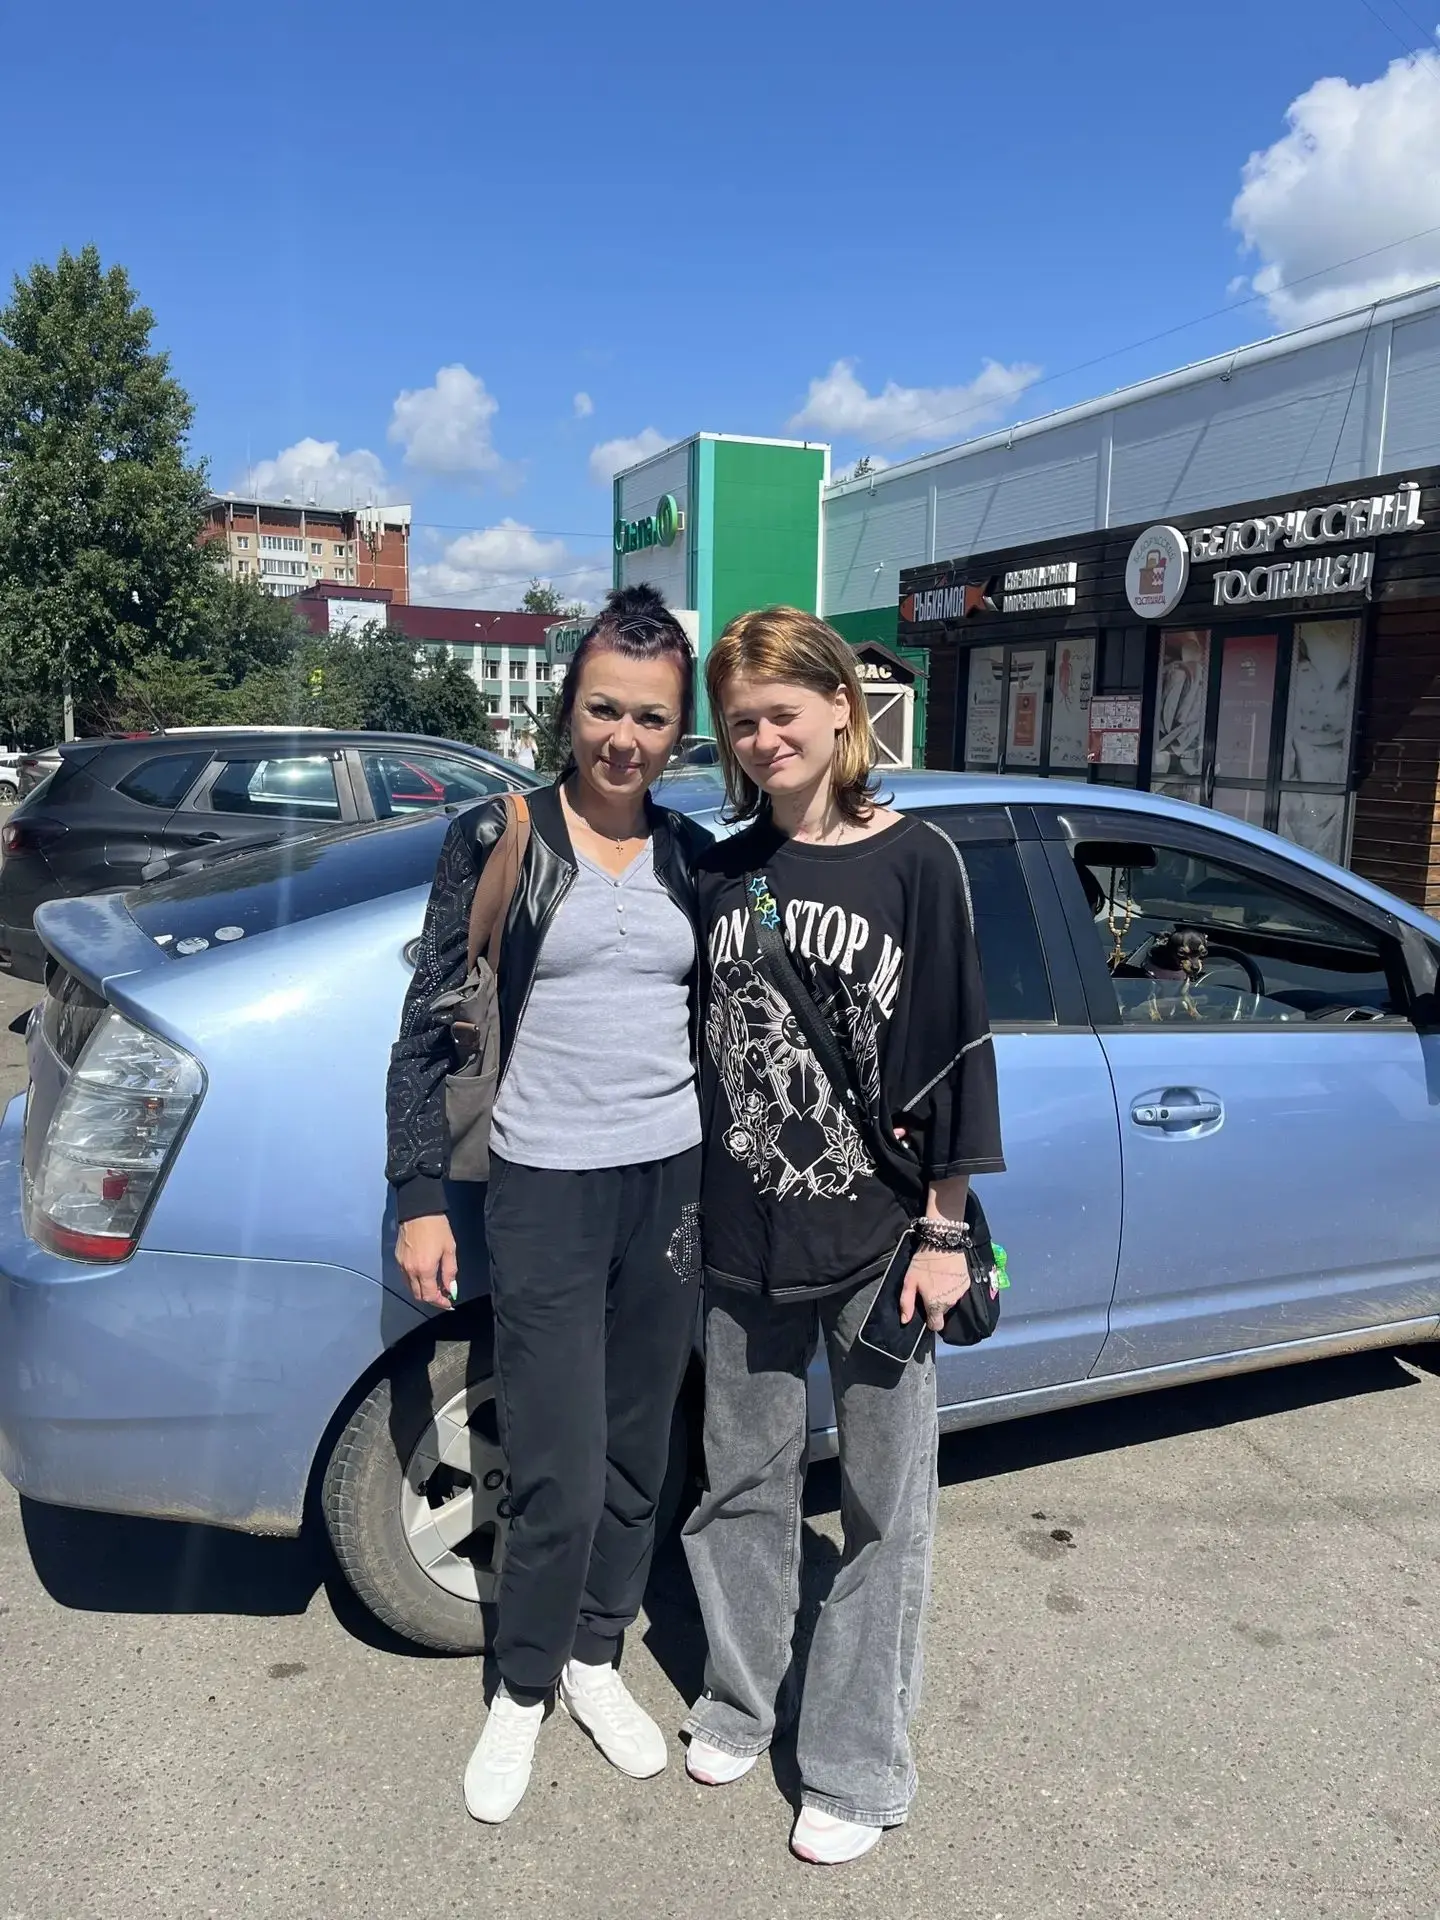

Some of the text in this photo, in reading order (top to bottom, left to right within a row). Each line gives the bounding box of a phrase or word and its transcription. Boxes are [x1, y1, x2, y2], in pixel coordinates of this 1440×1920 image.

[1190, 482, 1425, 563] БЕЛОРУССКИЙ
[1213, 552, 1375, 606] ГОСТИНЕЦ
[943, 585, 966, 619] МОЯ
[555, 629, 589, 654] СУПЕР
[854, 663, 892, 679] ВАС
[708, 907, 750, 974] ON
[784, 899, 869, 975] STOP
[807, 1173, 850, 1201] Rock
